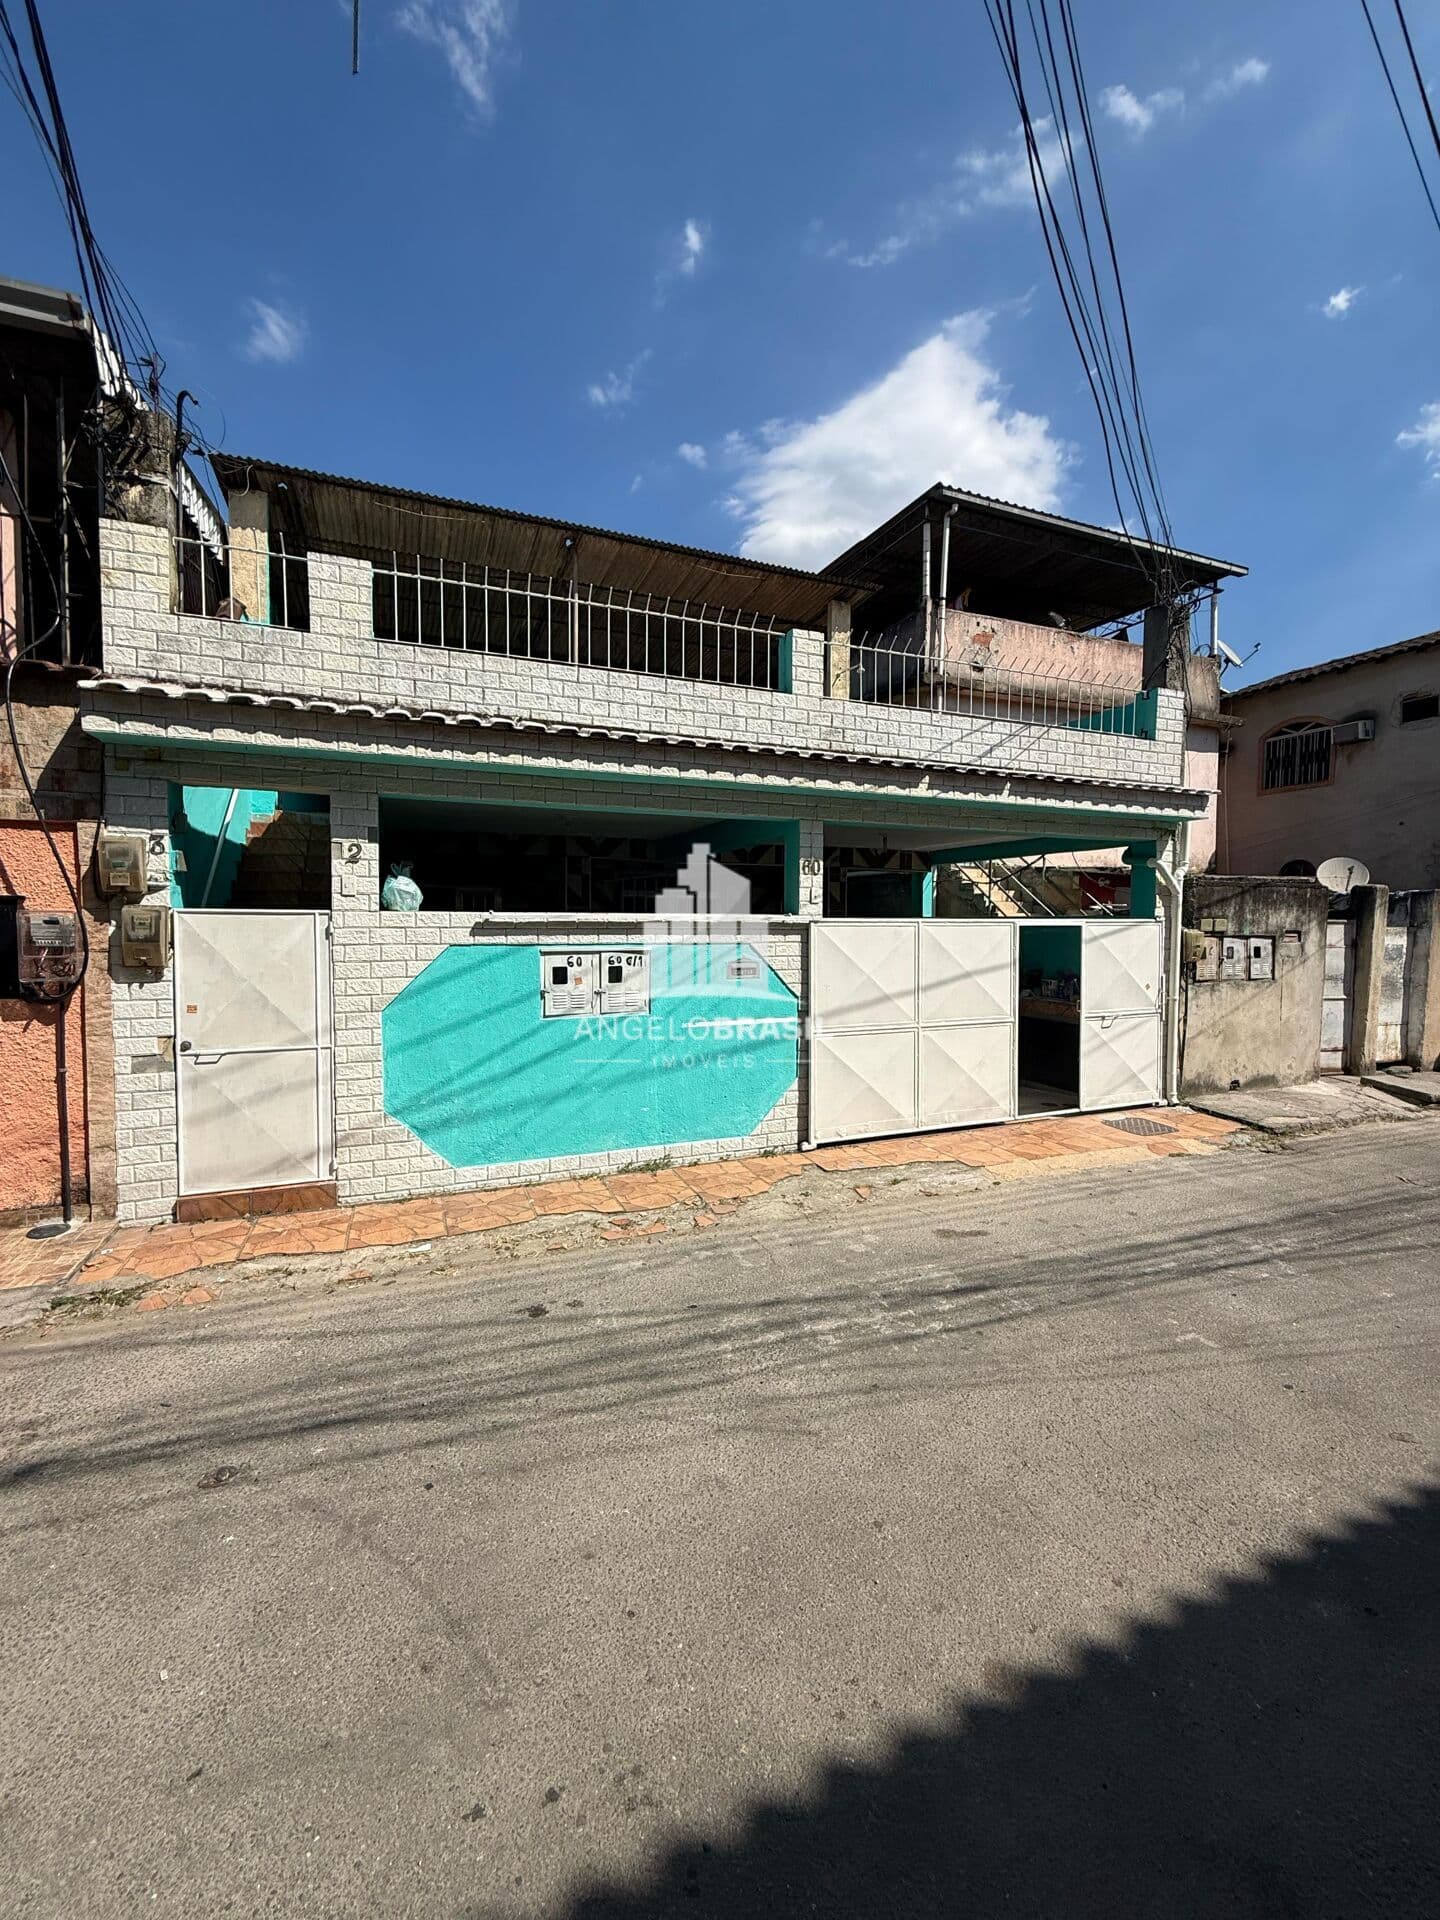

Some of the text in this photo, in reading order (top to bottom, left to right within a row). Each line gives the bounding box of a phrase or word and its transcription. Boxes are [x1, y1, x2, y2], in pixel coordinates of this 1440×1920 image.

[345, 843, 362, 864] 2
[802, 859, 820, 876] 60
[567, 956, 582, 967] 60
[608, 955, 622, 965] 60
